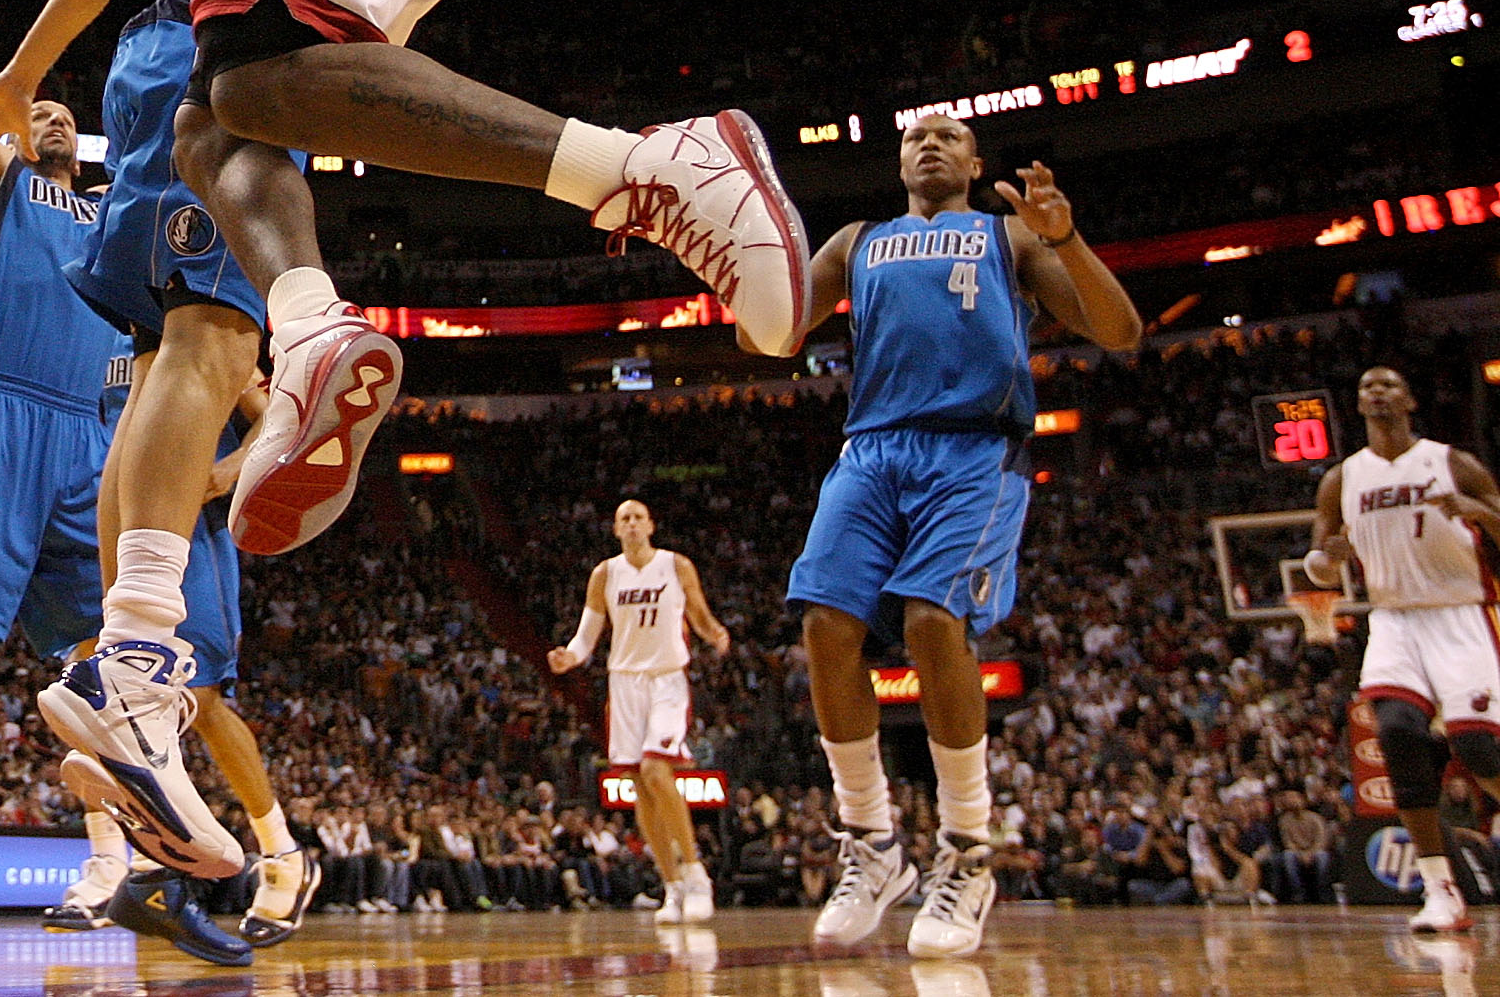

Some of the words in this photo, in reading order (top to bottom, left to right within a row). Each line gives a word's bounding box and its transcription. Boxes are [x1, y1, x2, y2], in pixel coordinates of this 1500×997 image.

[1145, 38, 1250, 89] HEAT
[1284, 30, 1313, 63] 2
[974, 85, 1044, 116] STATS
[866, 228, 989, 270] DALLAS
[947, 261, 980, 312] 4
[1273, 418, 1330, 463] 20
[1359, 477, 1437, 514] HEAT
[1412, 510, 1426, 539] 1
[616, 583, 669, 606] HEAT
[637, 607, 659, 629] 11
[5, 866, 82, 886] CONFID
